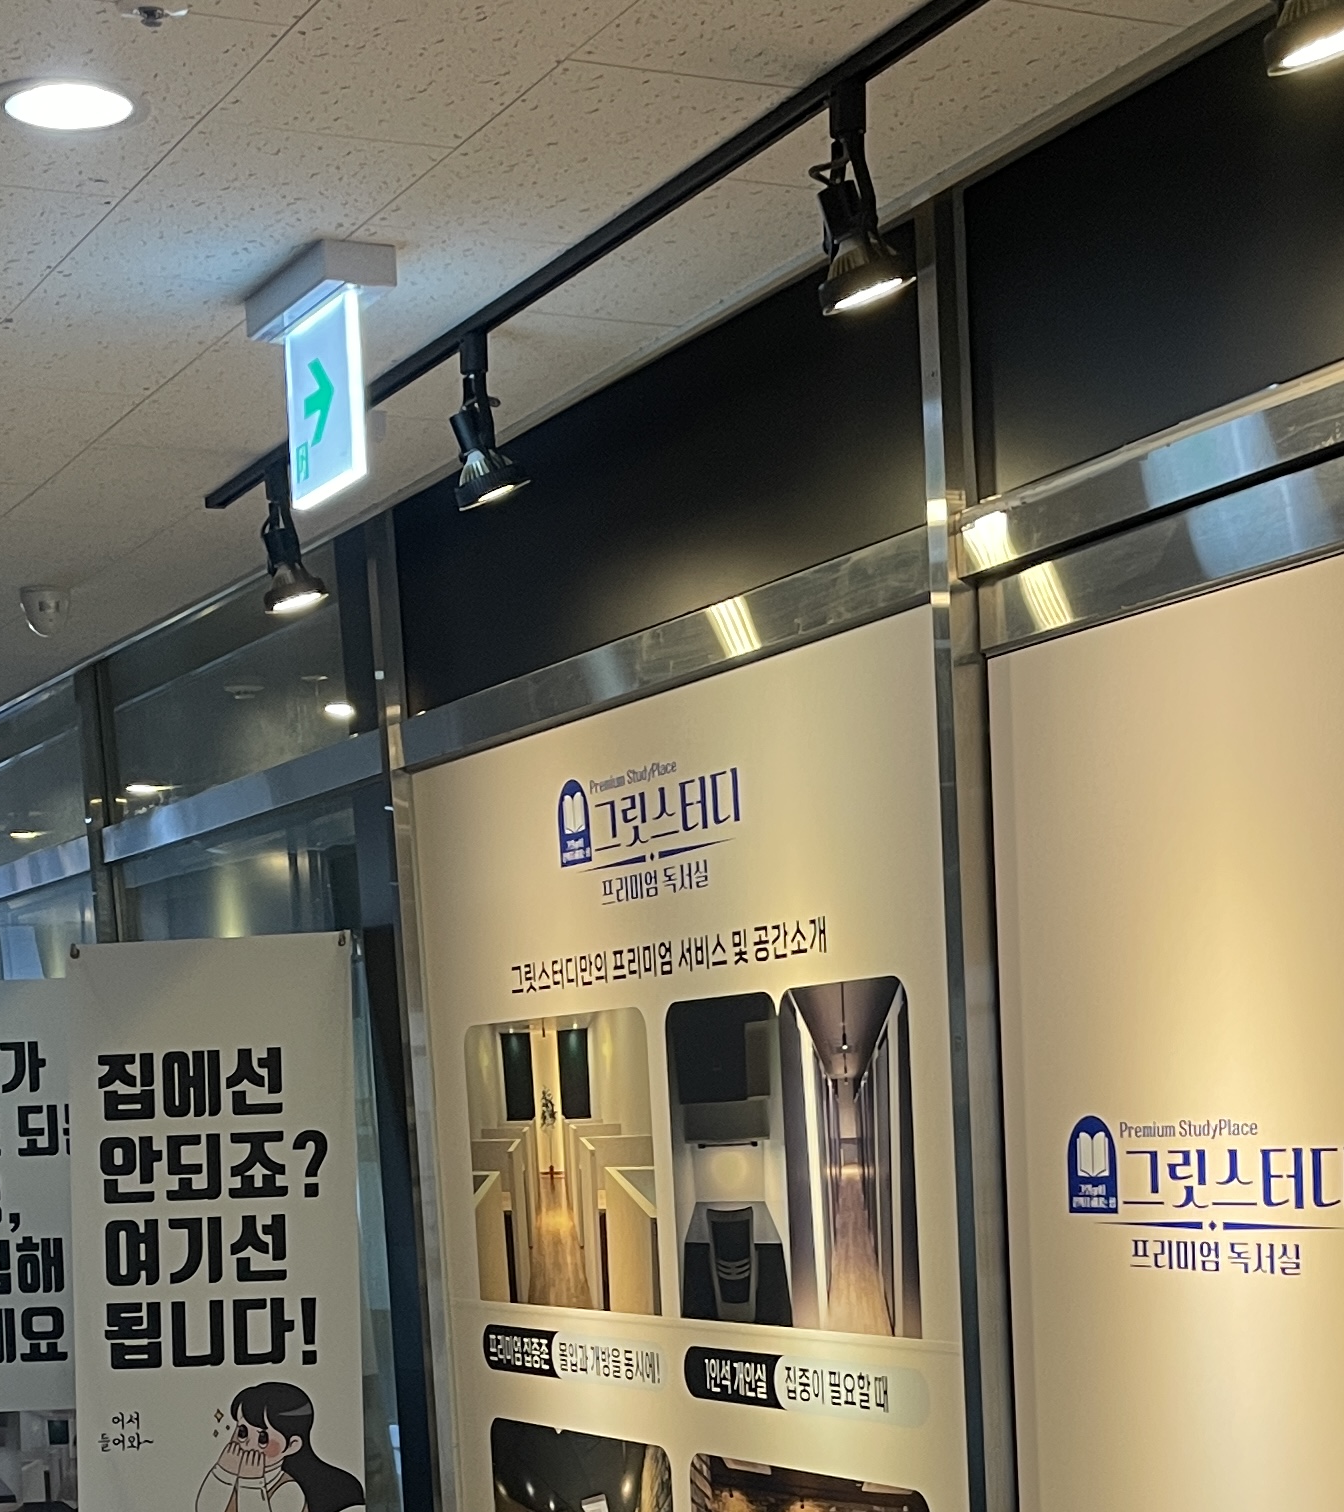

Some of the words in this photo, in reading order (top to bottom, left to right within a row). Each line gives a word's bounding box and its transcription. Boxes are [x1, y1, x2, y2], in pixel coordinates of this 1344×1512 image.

[589, 774, 626, 795] Premium
[594, 766, 741, 853] 그릿스터디
[601, 869, 659, 906] 프리미엄
[662, 858, 709, 894] 독서실
[510, 950, 609, 995] 그릿스터디만의
[611, 940, 673, 981] 프리미엄
[678, 933, 728, 973] 서비스
[731, 927, 749, 966] 및
[753, 915, 828, 962] 공간소개
[96, 1046, 284, 1122] 집에선
[17, 1103, 71, 1157] 되
[1118, 1120, 1176, 1139] Premium
[1178, 1118, 1259, 1140] StudyPlace
[99, 1128, 329, 1204] 안되죠?
[103, 1213, 288, 1287] 여기선
[1129, 1238, 1220, 1273] 프리미엄
[1227, 1241, 1302, 1276] 독서실
[103, 1296, 319, 1370] 됩니다!
[488, 1333, 522, 1366] 프리미엄
[522, 1337, 550, 1370] 집중존
[558, 1341, 589, 1375] 몰입과
[590, 1345, 622, 1379] 개방을
[623, 1349, 661, 1384] 동시에!
[704, 1358, 732, 1395] 1인석
[732, 1361, 768, 1400] 개인실
[784, 1365, 825, 1405] 집중이
[828, 1370, 871, 1410] 필요할
[874, 1374, 890, 1414] 때
[111, 1410, 140, 1430] 어서
